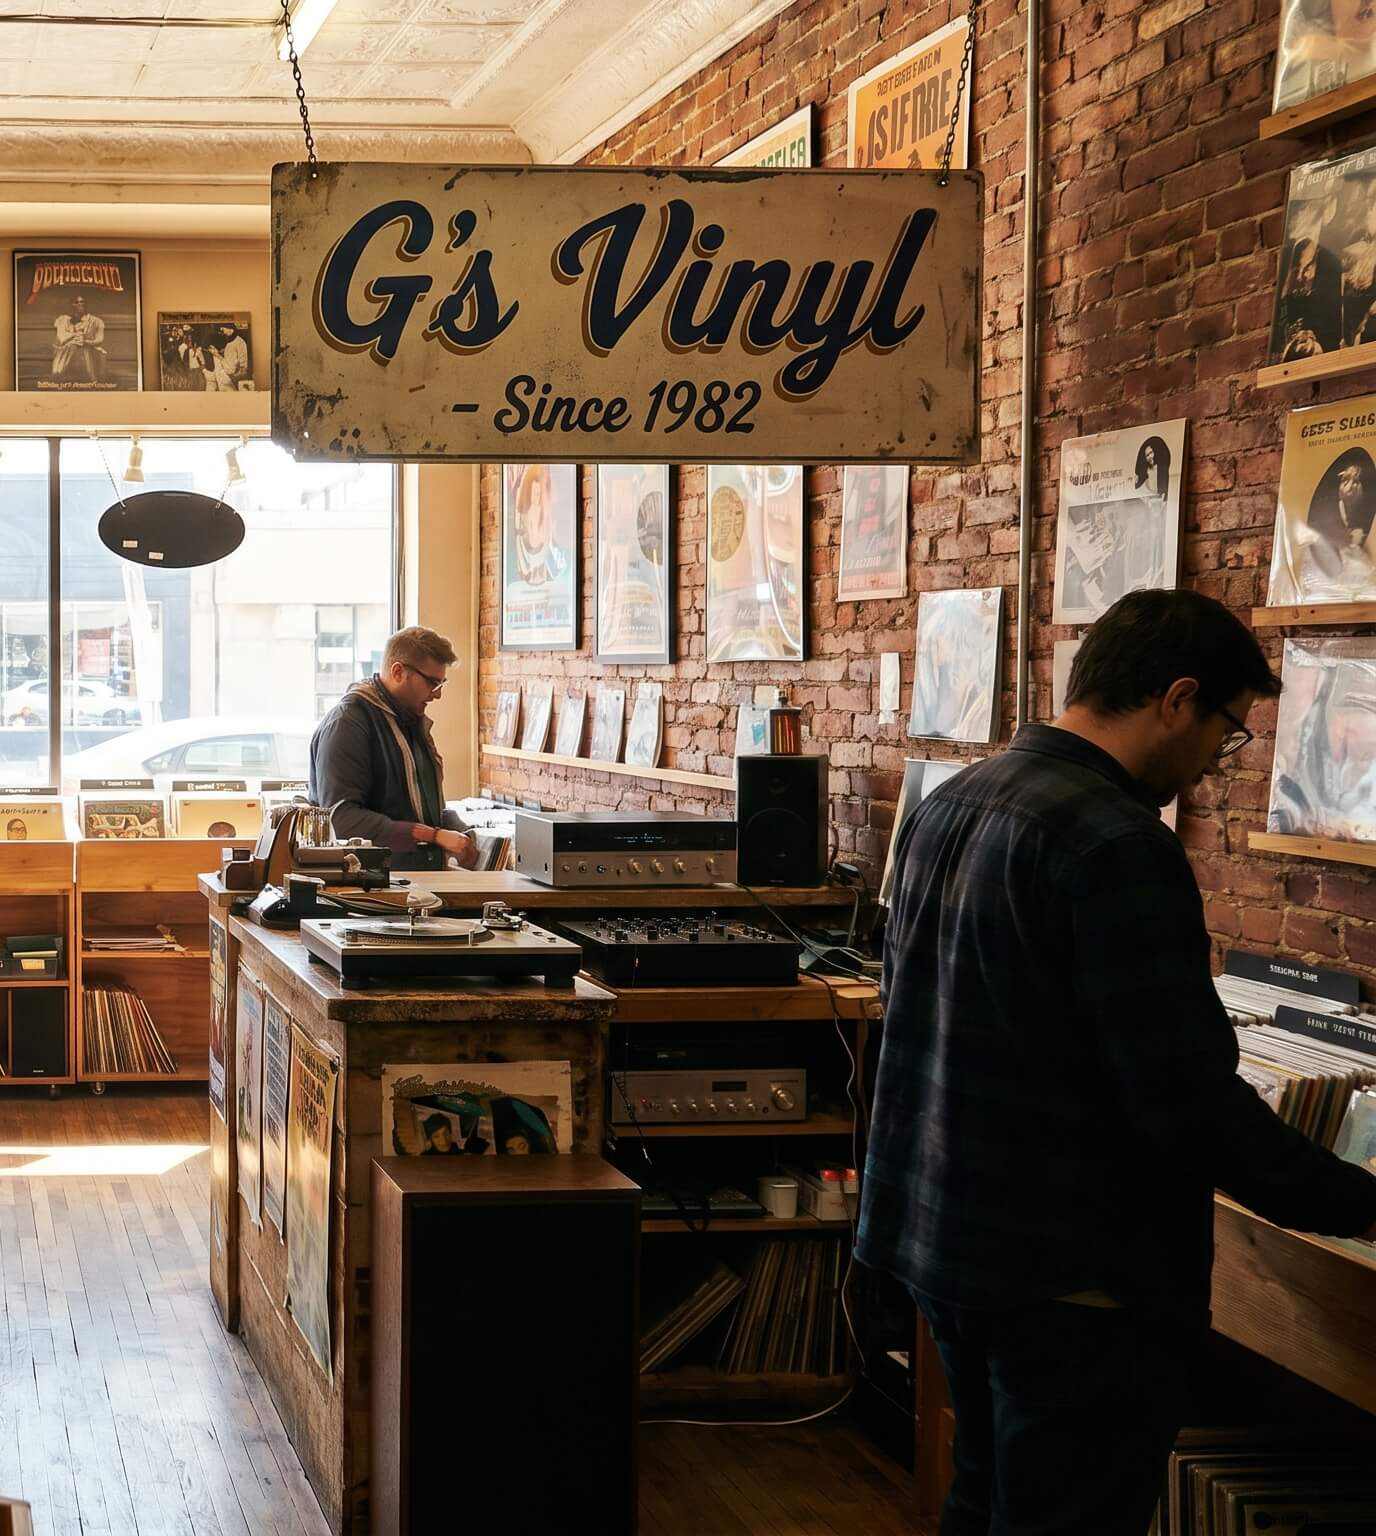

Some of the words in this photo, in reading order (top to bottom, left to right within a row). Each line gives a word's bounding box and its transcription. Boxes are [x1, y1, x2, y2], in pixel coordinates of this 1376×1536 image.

[313, 199, 520, 367] G's
[551, 199, 938, 403] Vinyl
[493, 375, 632, 434] Since
[644, 380, 762, 434] 1982
